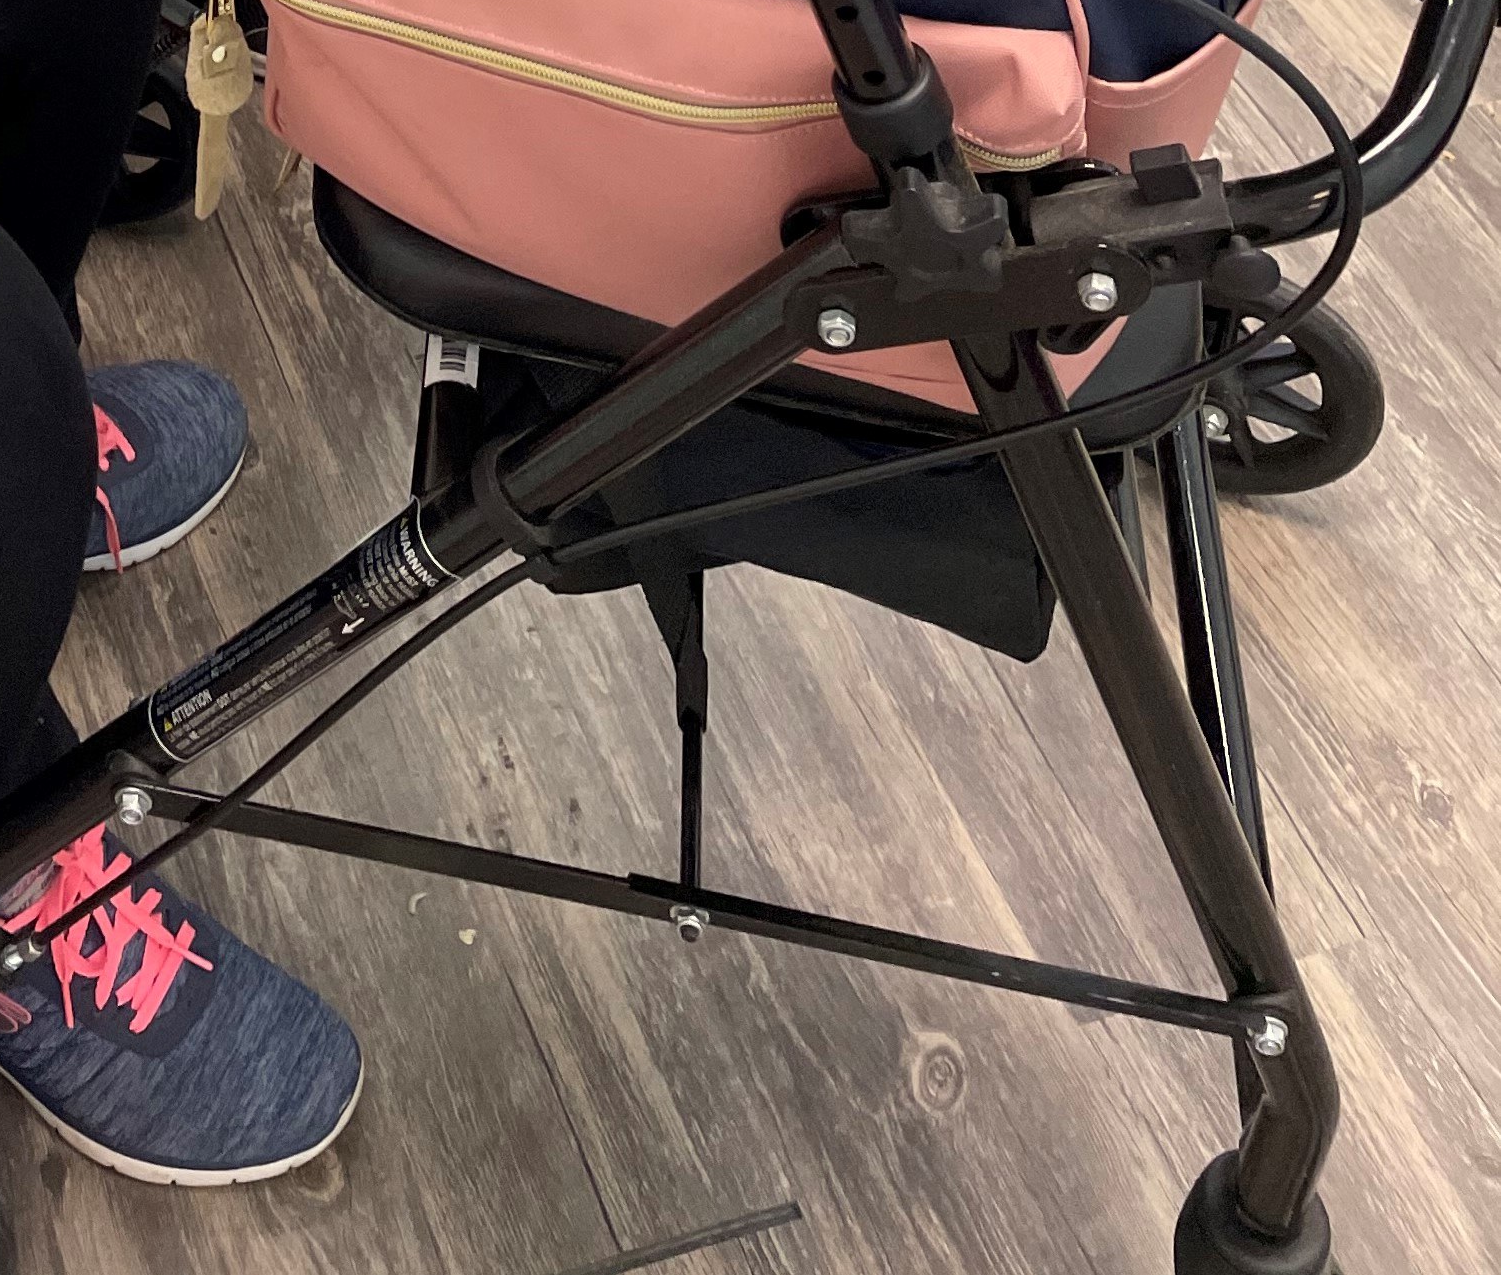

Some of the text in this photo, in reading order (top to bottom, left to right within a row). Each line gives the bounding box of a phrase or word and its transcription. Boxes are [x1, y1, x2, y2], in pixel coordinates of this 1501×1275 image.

[400, 526, 439, 588] WARNING
[399, 565, 419, 587] MUST
[172, 689, 213, 726] ATTENTION
